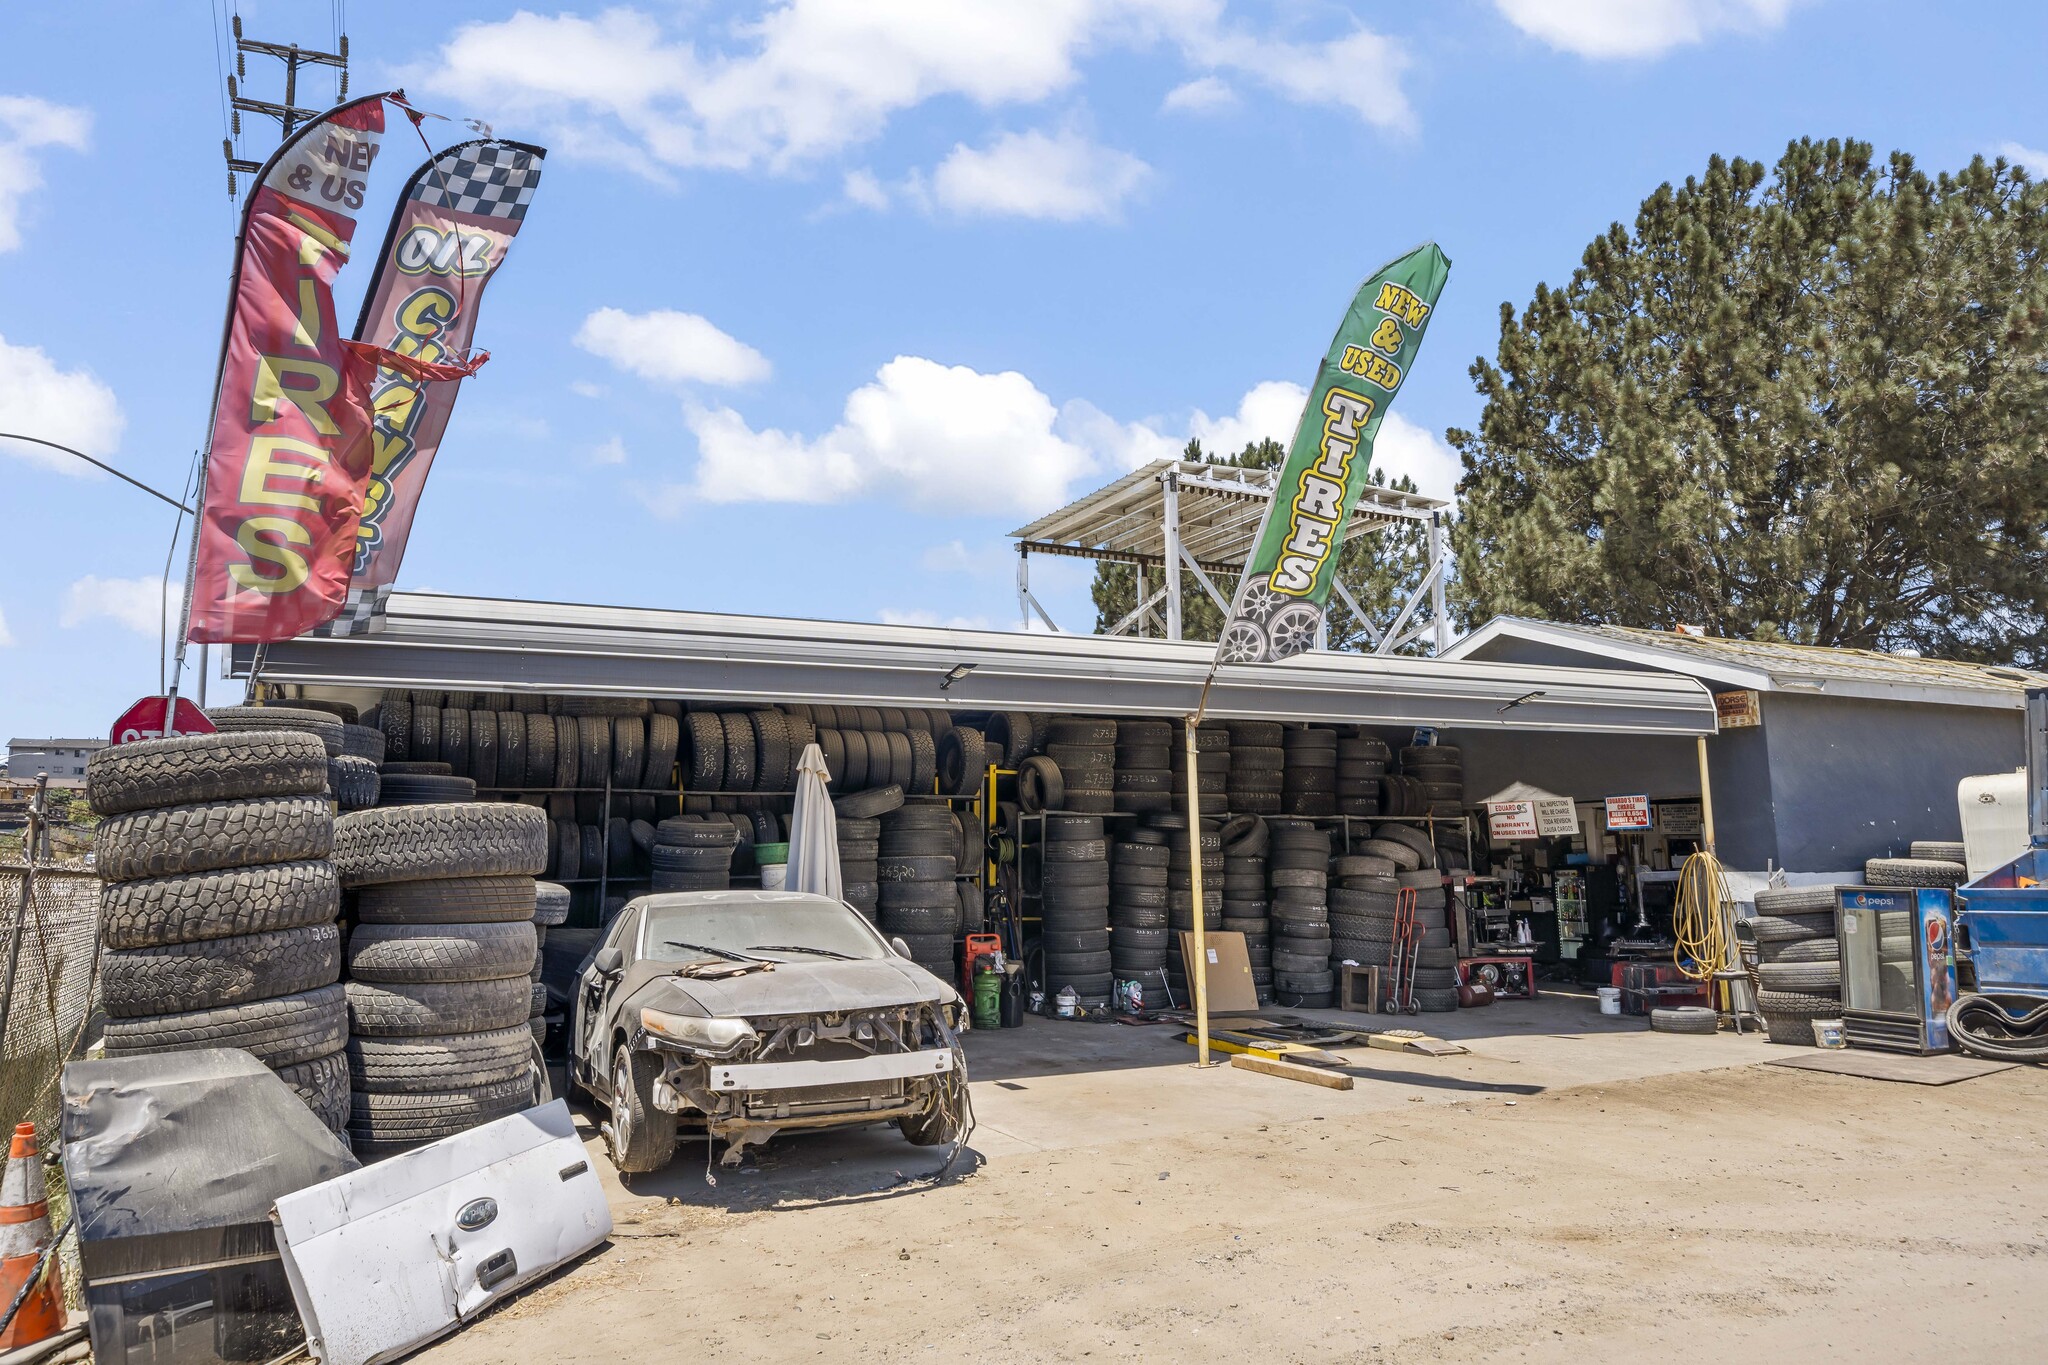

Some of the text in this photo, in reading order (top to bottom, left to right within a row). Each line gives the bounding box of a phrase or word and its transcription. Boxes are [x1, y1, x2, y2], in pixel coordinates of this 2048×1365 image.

[394, 224, 492, 277] OIL
[1375, 282, 1429, 329] NEW
[1371, 317, 1403, 354] &
[1340, 346, 1401, 391] USED
[1270, 388, 1374, 595] TIRES
[1868, 898, 1894, 906] pepsi
